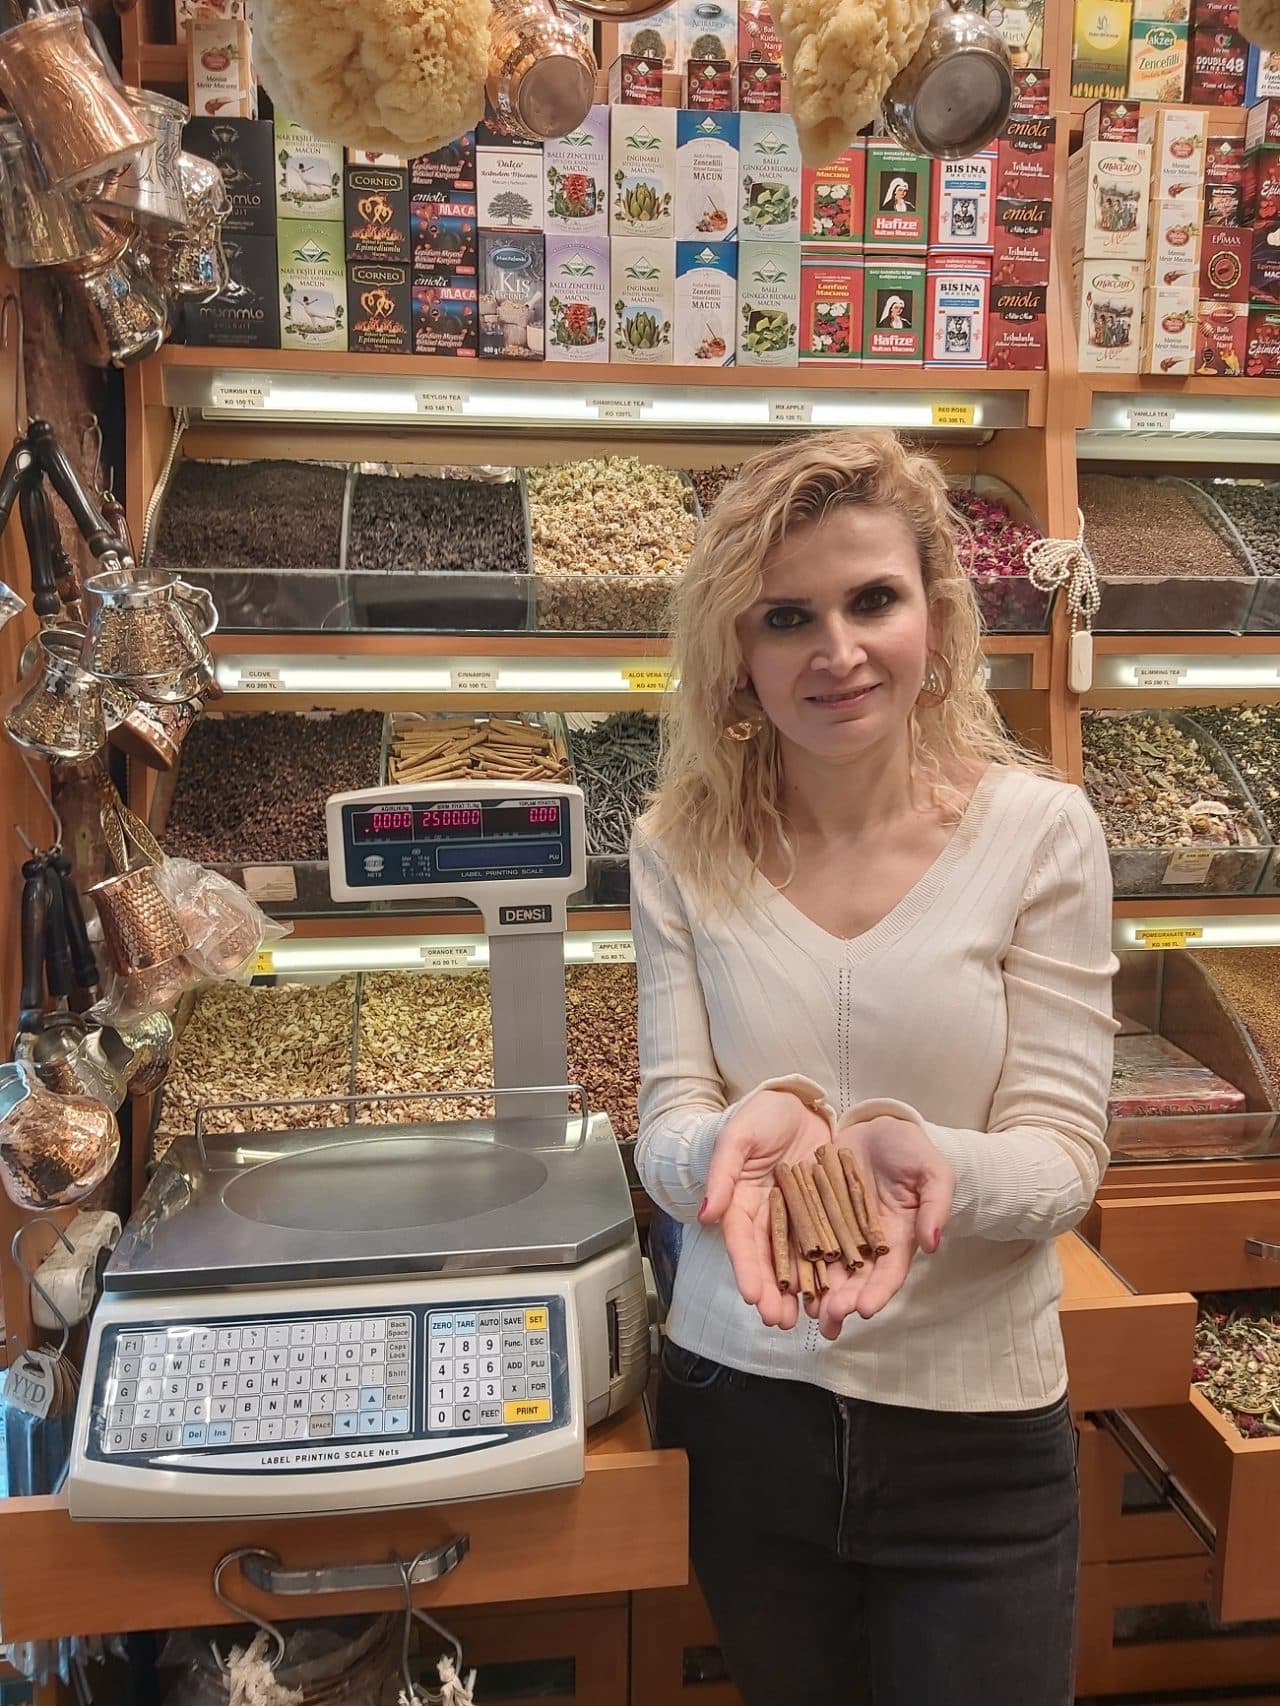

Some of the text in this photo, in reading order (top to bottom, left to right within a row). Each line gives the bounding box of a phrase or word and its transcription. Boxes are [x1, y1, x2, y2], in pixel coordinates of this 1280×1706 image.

[1138, 54, 1180, 70] Zencefilli
[1226, 58, 1244, 72] 48
[1008, 121, 1050, 136] eniola
[354, 176, 397, 186] CORNEO
[693, 172, 723, 180] MACUN
[440, 204, 476, 216] MACA
[1003, 206, 1046, 222] eniola
[358, 270, 400, 280] CORNEO
[440, 288, 477, 300] MACA
[998, 291, 1040, 308] eniola
[692, 300, 721, 309] MACUN
[432, 1322, 452, 1330] ZERO
[456, 1320, 475, 1328] TARE
[480, 1318, 498, 1326] AUTO
[504, 1317, 522, 1326] SAVE
[126, 1341, 137, 1351] F1
[390, 1343, 406, 1352] Caps
[438, 1343, 446, 1353] 7
[462, 1341, 470, 1352] 8
[486, 1340, 494, 1350] 9
[504, 1339, 522, 1348] Func.
[149, 1362, 156, 1372] Q
[172, 1361, 182, 1370] W
[199, 1360, 206, 1368] E
[224, 1358, 230, 1367] R
[249, 1356, 255, 1366] T
[273, 1355, 280, 1364] Y
[298, 1353, 304, 1362] U
[346, 1350, 353, 1358] O
[370, 1348, 376, 1357] P
[390, 1352, 406, 1360] Lock
[388, 1369, 406, 1378] Shift
[438, 1360, 545, 1375] 4 5 6 ADD PLU
[14, 1373, 46, 1405] YYD
[146, 1373, 352, 1395] A S D F G H J K L
[388, 1392, 406, 1402] Enter
[439, 1383, 546, 1399] 1 2 3 X FOR
[438, 1409, 499, 1422] 0 C FEED
[516, 1406, 538, 1416] PRINT
[188, 1428, 226, 1439] Del Ins
[261, 1448, 400, 1465] LABEL PRINTING SCALE Nets
